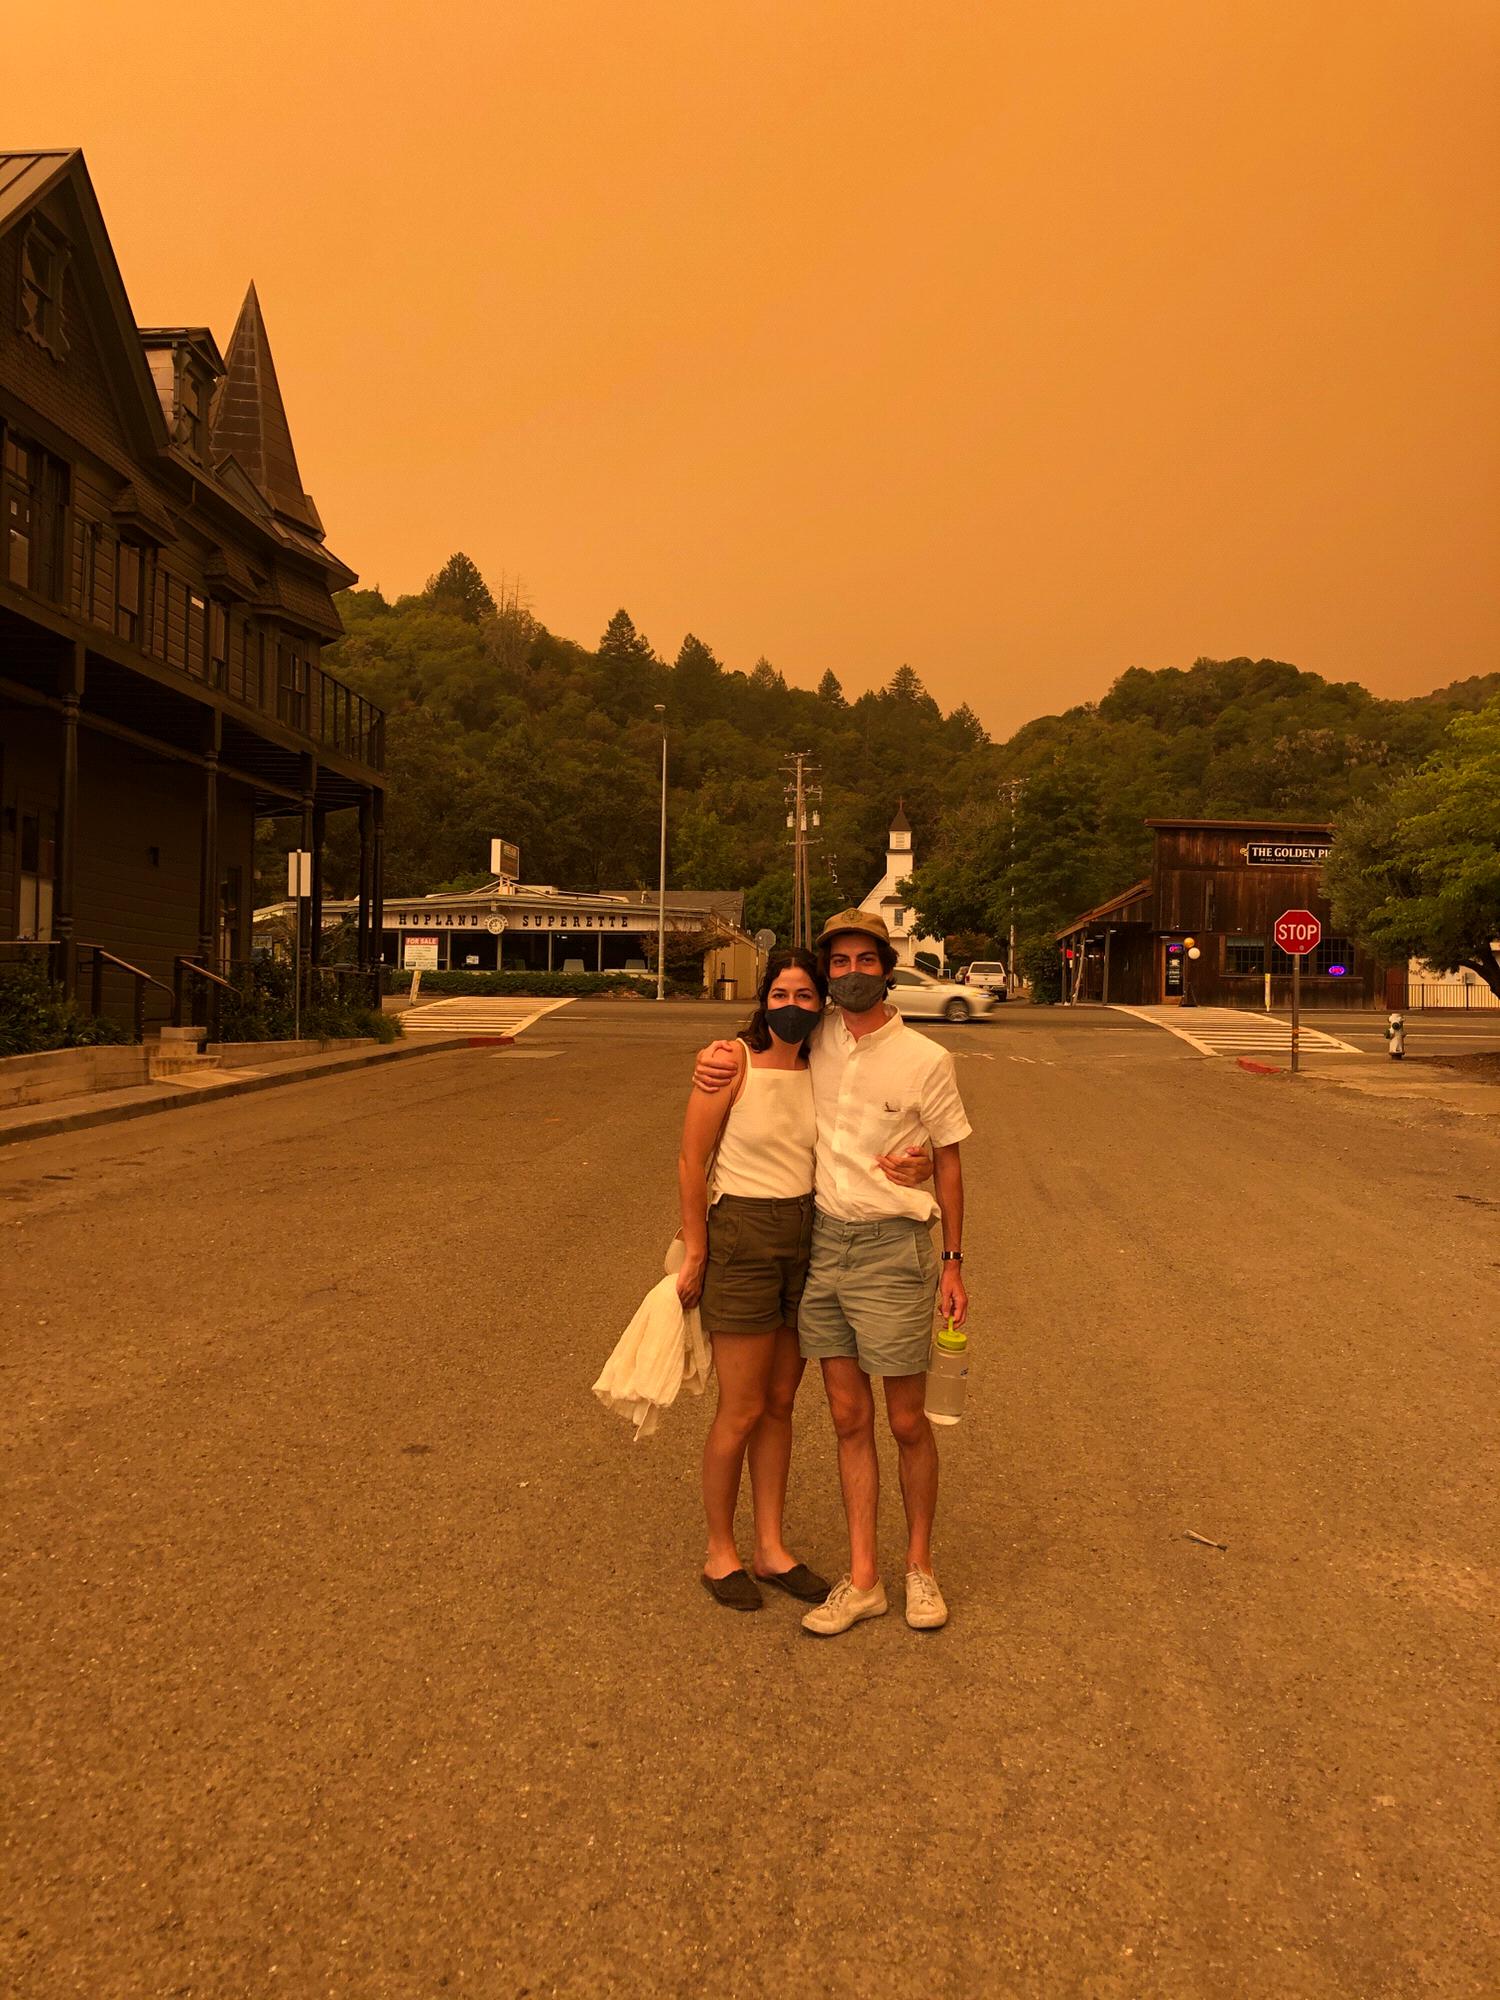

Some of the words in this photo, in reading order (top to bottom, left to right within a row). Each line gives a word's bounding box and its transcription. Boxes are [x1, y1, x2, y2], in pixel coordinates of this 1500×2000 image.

[1252, 847, 1272, 857] THE
[1274, 847, 1316, 858] GOLDEN
[398, 914, 478, 926] HOPLAND
[522, 915, 628, 927] SUPERETTE
[1278, 924, 1317, 940] STOP
[406, 937, 419, 945] FOR
[420, 937, 436, 945] SALE
